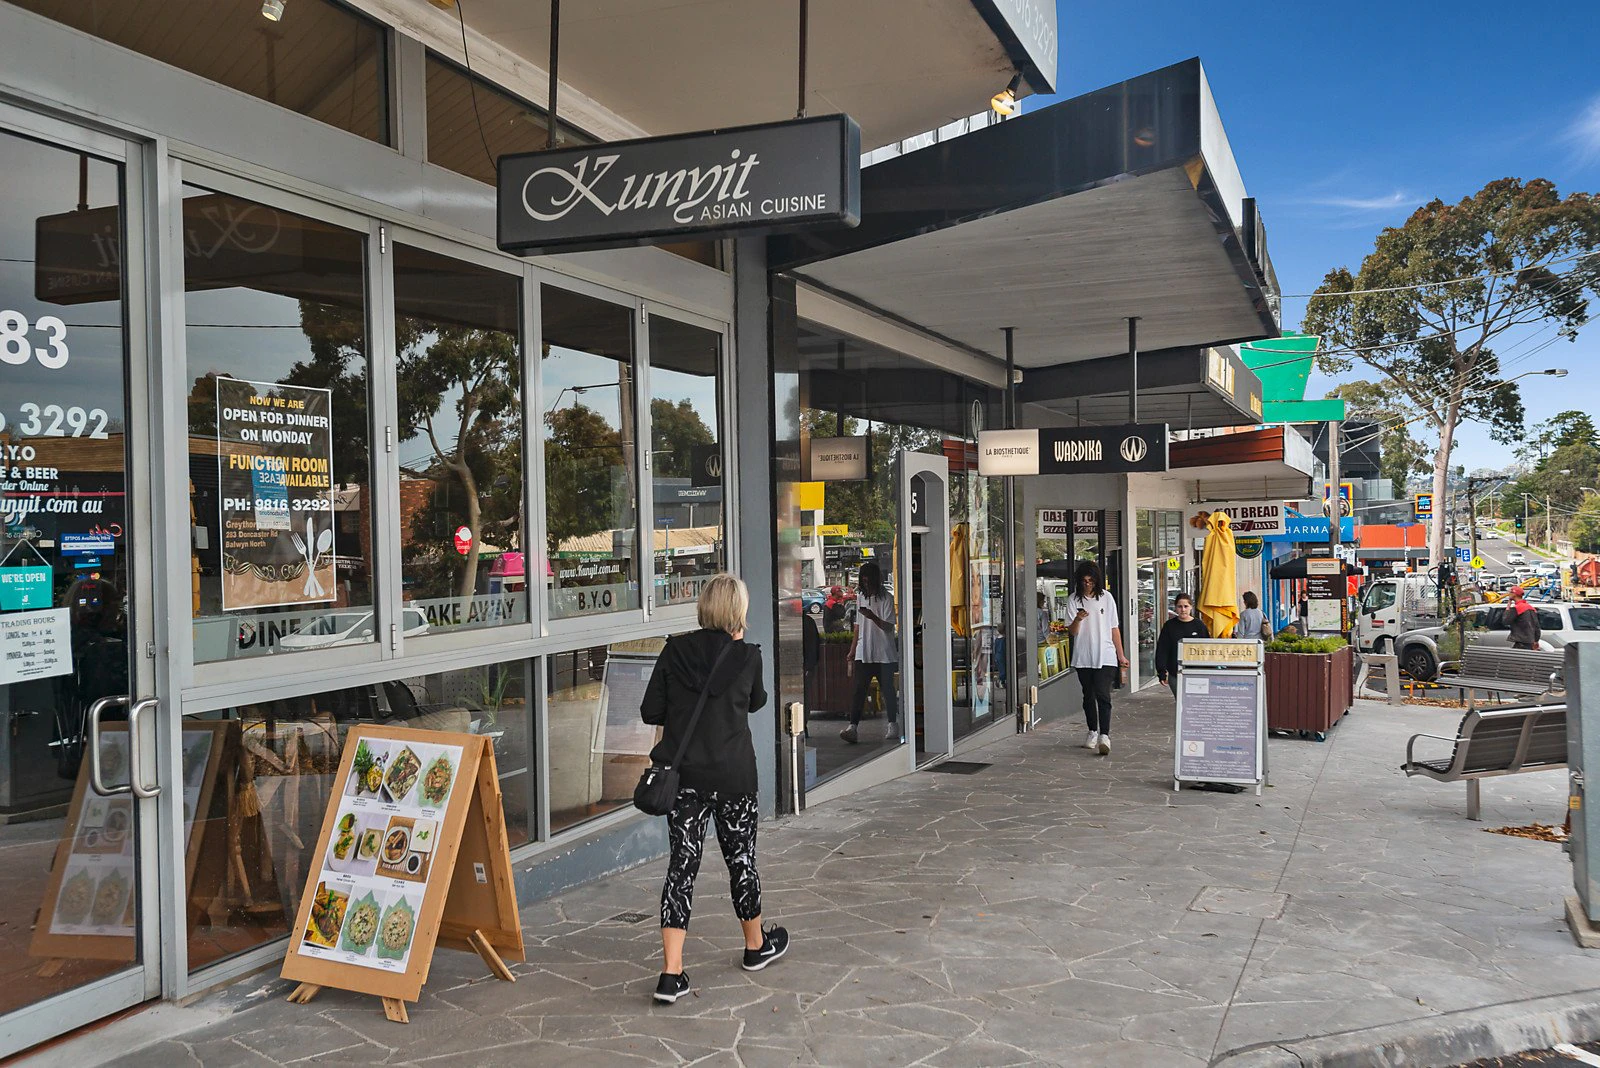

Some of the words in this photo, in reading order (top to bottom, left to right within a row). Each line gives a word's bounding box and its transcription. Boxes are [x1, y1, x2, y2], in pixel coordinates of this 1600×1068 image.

[522, 149, 760, 224] Kunyit
[700, 201, 752, 220] ASIAN
[761, 194, 826, 215] CUISINE
[250, 396, 271, 407] NOW
[273, 398, 285, 408] WE
[288, 399, 305, 409] ARE
[20, 402, 109, 440] 3292
[223, 408, 257, 422] OPEN
[260, 411, 284, 424] FOR
[287, 413, 329, 428] DINNER
[241, 429, 258, 441] ON
[262, 430, 313, 445] MONDAY
[1054, 440, 1103, 462] WARDIKA
[229, 454, 290, 472] FUNCTION
[292, 458, 328, 473] ROOM
[26, 467, 59, 479] BEER
[19, 480, 49, 491] Online
[279, 473, 329, 487] AVAILABLE
[223, 498, 251, 510] PH:
[255, 498, 288, 510] 9816
[292, 499, 330, 510] 3292
[1241, 505, 1278, 518] BREAD
[226, 531, 237, 539] 283
[239, 530, 269, 539] Doncaster
[270, 529, 278, 537] Rd
[1285, 526, 1346, 534] HARMAY
[226, 541, 249, 549] Balwyn
[250, 540, 266, 548] North
[1, 572, 24, 583] WE'RE
[25, 572, 46, 583] OPEN
[578, 590, 612, 610] B.Y.O
[467, 598, 515, 623] AWAY
[1, 619, 32, 629] TRADING
[33, 616, 56, 625] HOURS
